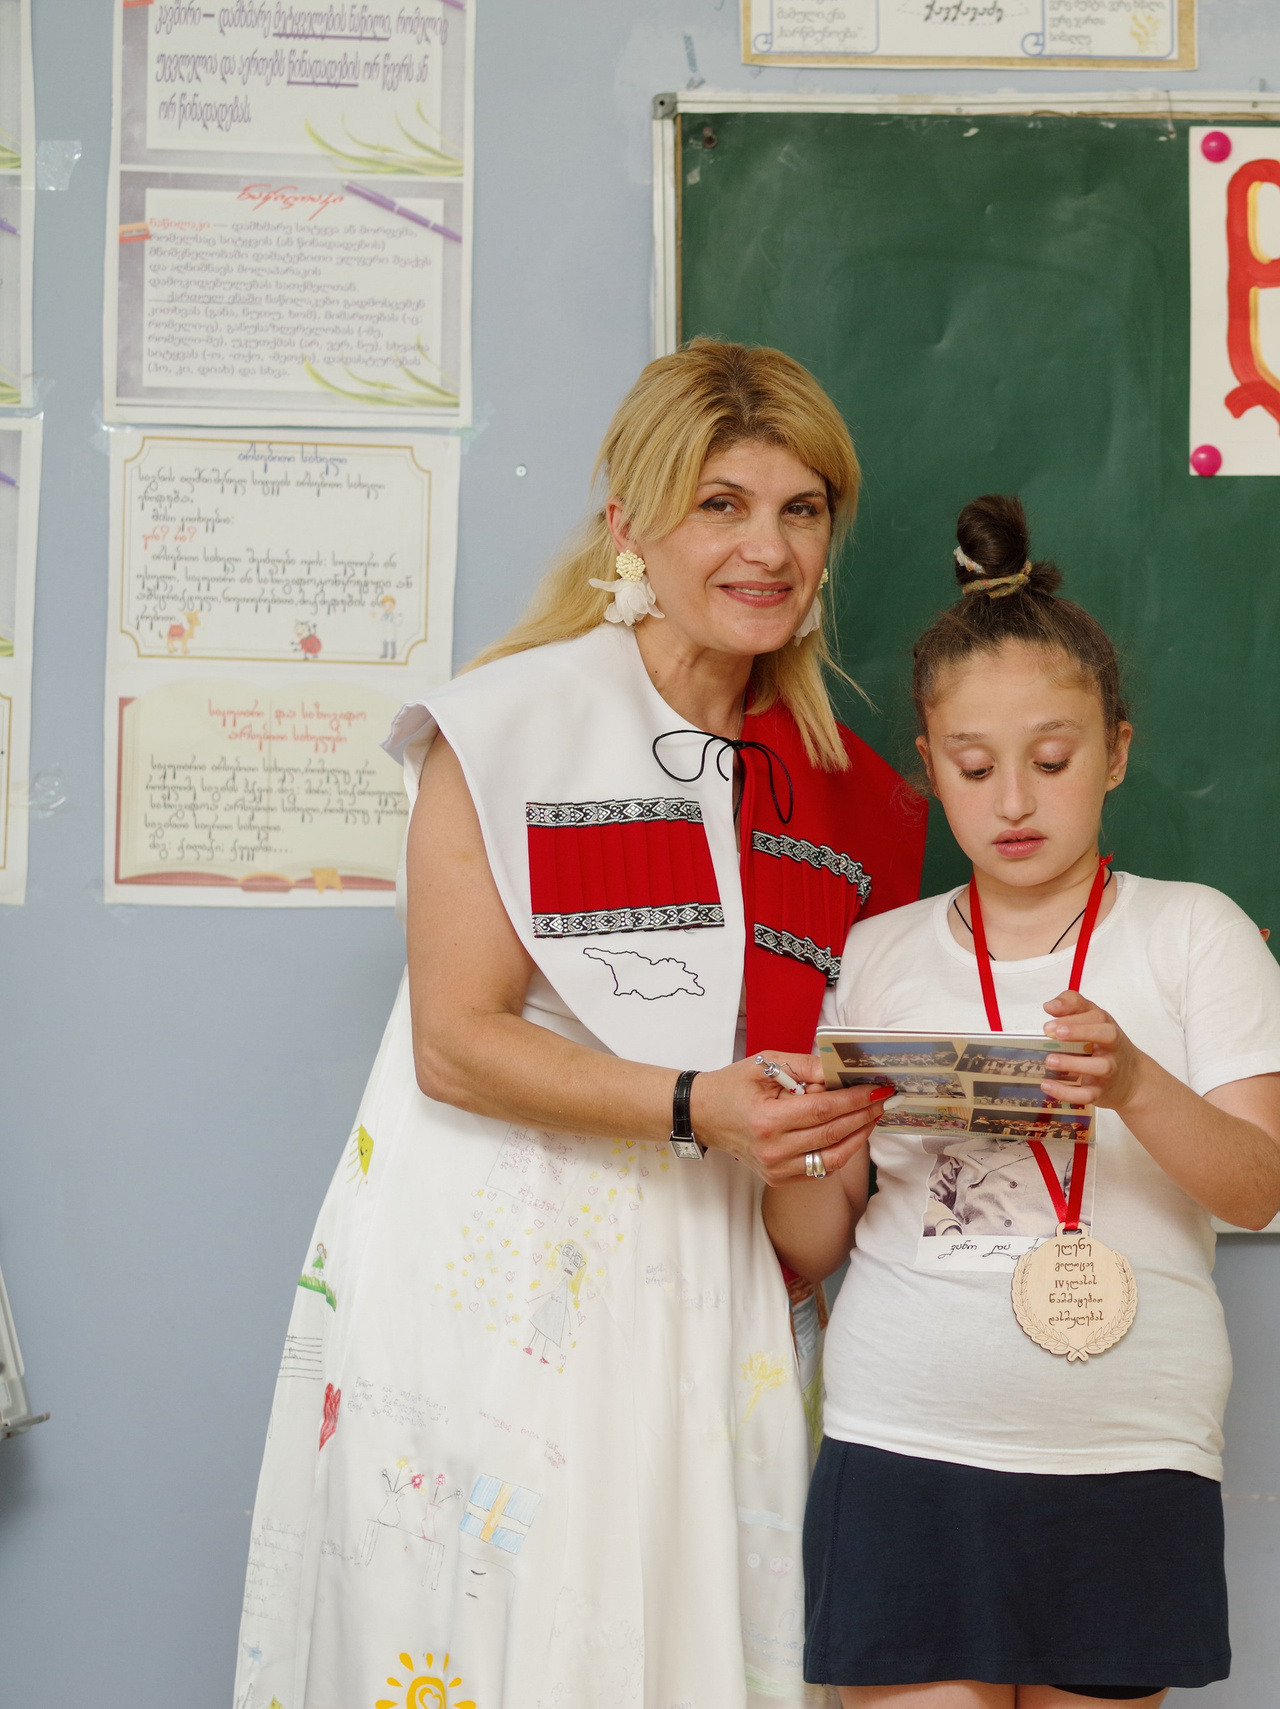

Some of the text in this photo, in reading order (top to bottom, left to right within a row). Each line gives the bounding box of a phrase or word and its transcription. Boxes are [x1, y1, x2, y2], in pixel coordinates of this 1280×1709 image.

[220, 54, 236, 84] და
[363, 54, 380, 80] ორ
[159, 92, 176, 120] ორ
[274, 708, 297, 725] და
[1055, 1237, 1093, 1258] ელენე
[1048, 1292, 1104, 1309] წარმატებით
